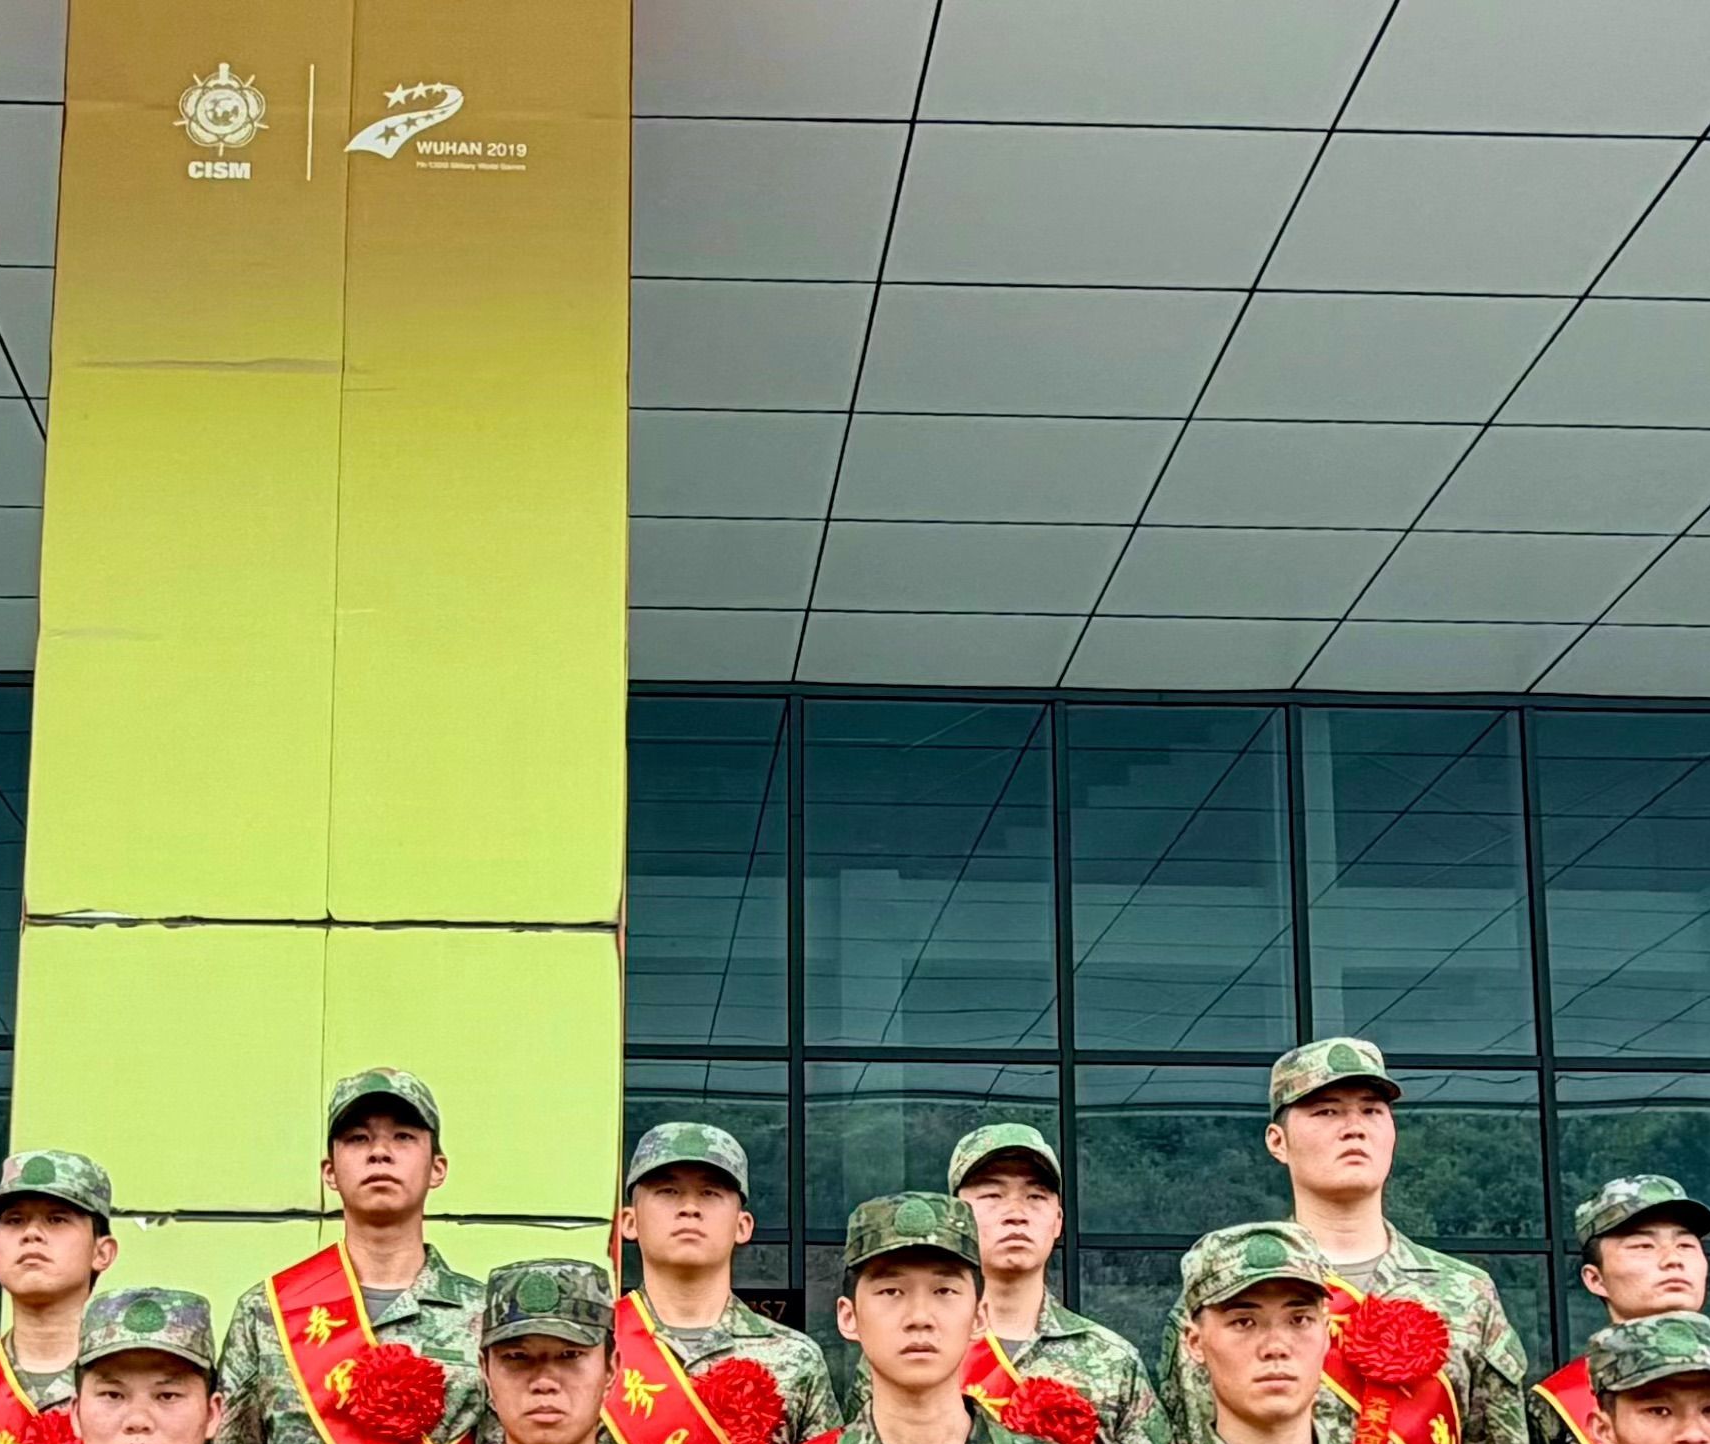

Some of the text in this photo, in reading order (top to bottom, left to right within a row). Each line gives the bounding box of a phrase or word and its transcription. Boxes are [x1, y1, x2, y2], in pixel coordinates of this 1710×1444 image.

[416, 141, 527, 157] WUHAN 2019
[188, 162, 251, 179] CISM
